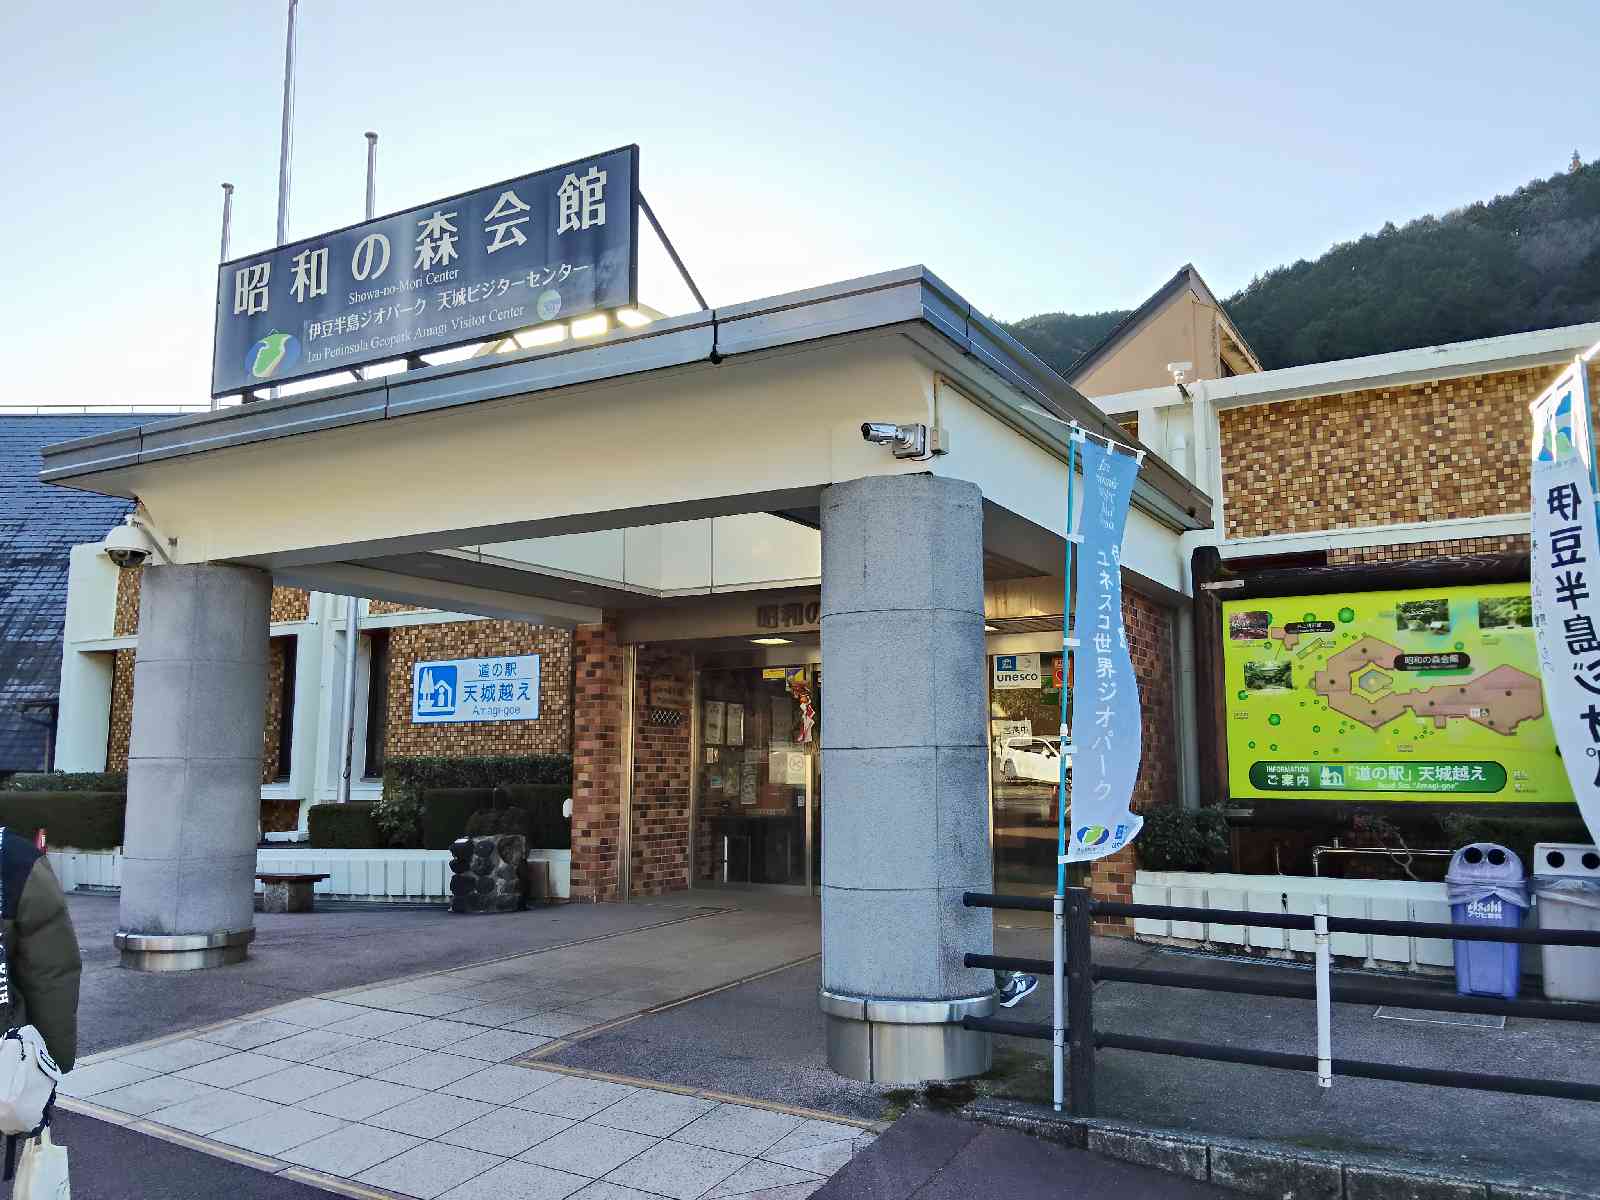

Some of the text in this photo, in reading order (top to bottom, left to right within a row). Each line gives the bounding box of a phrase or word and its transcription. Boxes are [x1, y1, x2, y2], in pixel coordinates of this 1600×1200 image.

[233, 166, 607, 316] 昭和の森会館
[426, 269, 460, 285] Center
[309, 264, 589, 341] 伊豆半島ジオパーク 天城ビジターセンター
[324, 339, 368, 359] Peninsula
[451, 312, 487, 330] Visitor
[489, 305, 525, 322] Center
[479, 663, 517, 678] 道の駅
[996, 673, 1038, 682] unesco
[1092, 551, 1116, 800] ユネスコ世界ジオパーク
[463, 682, 531, 703] 天城越え
[1266, 765, 1310, 773] INFORMATION
[1418, 766, 1486, 782] 天城越え
[1267, 774, 1309, 787] ご案内
